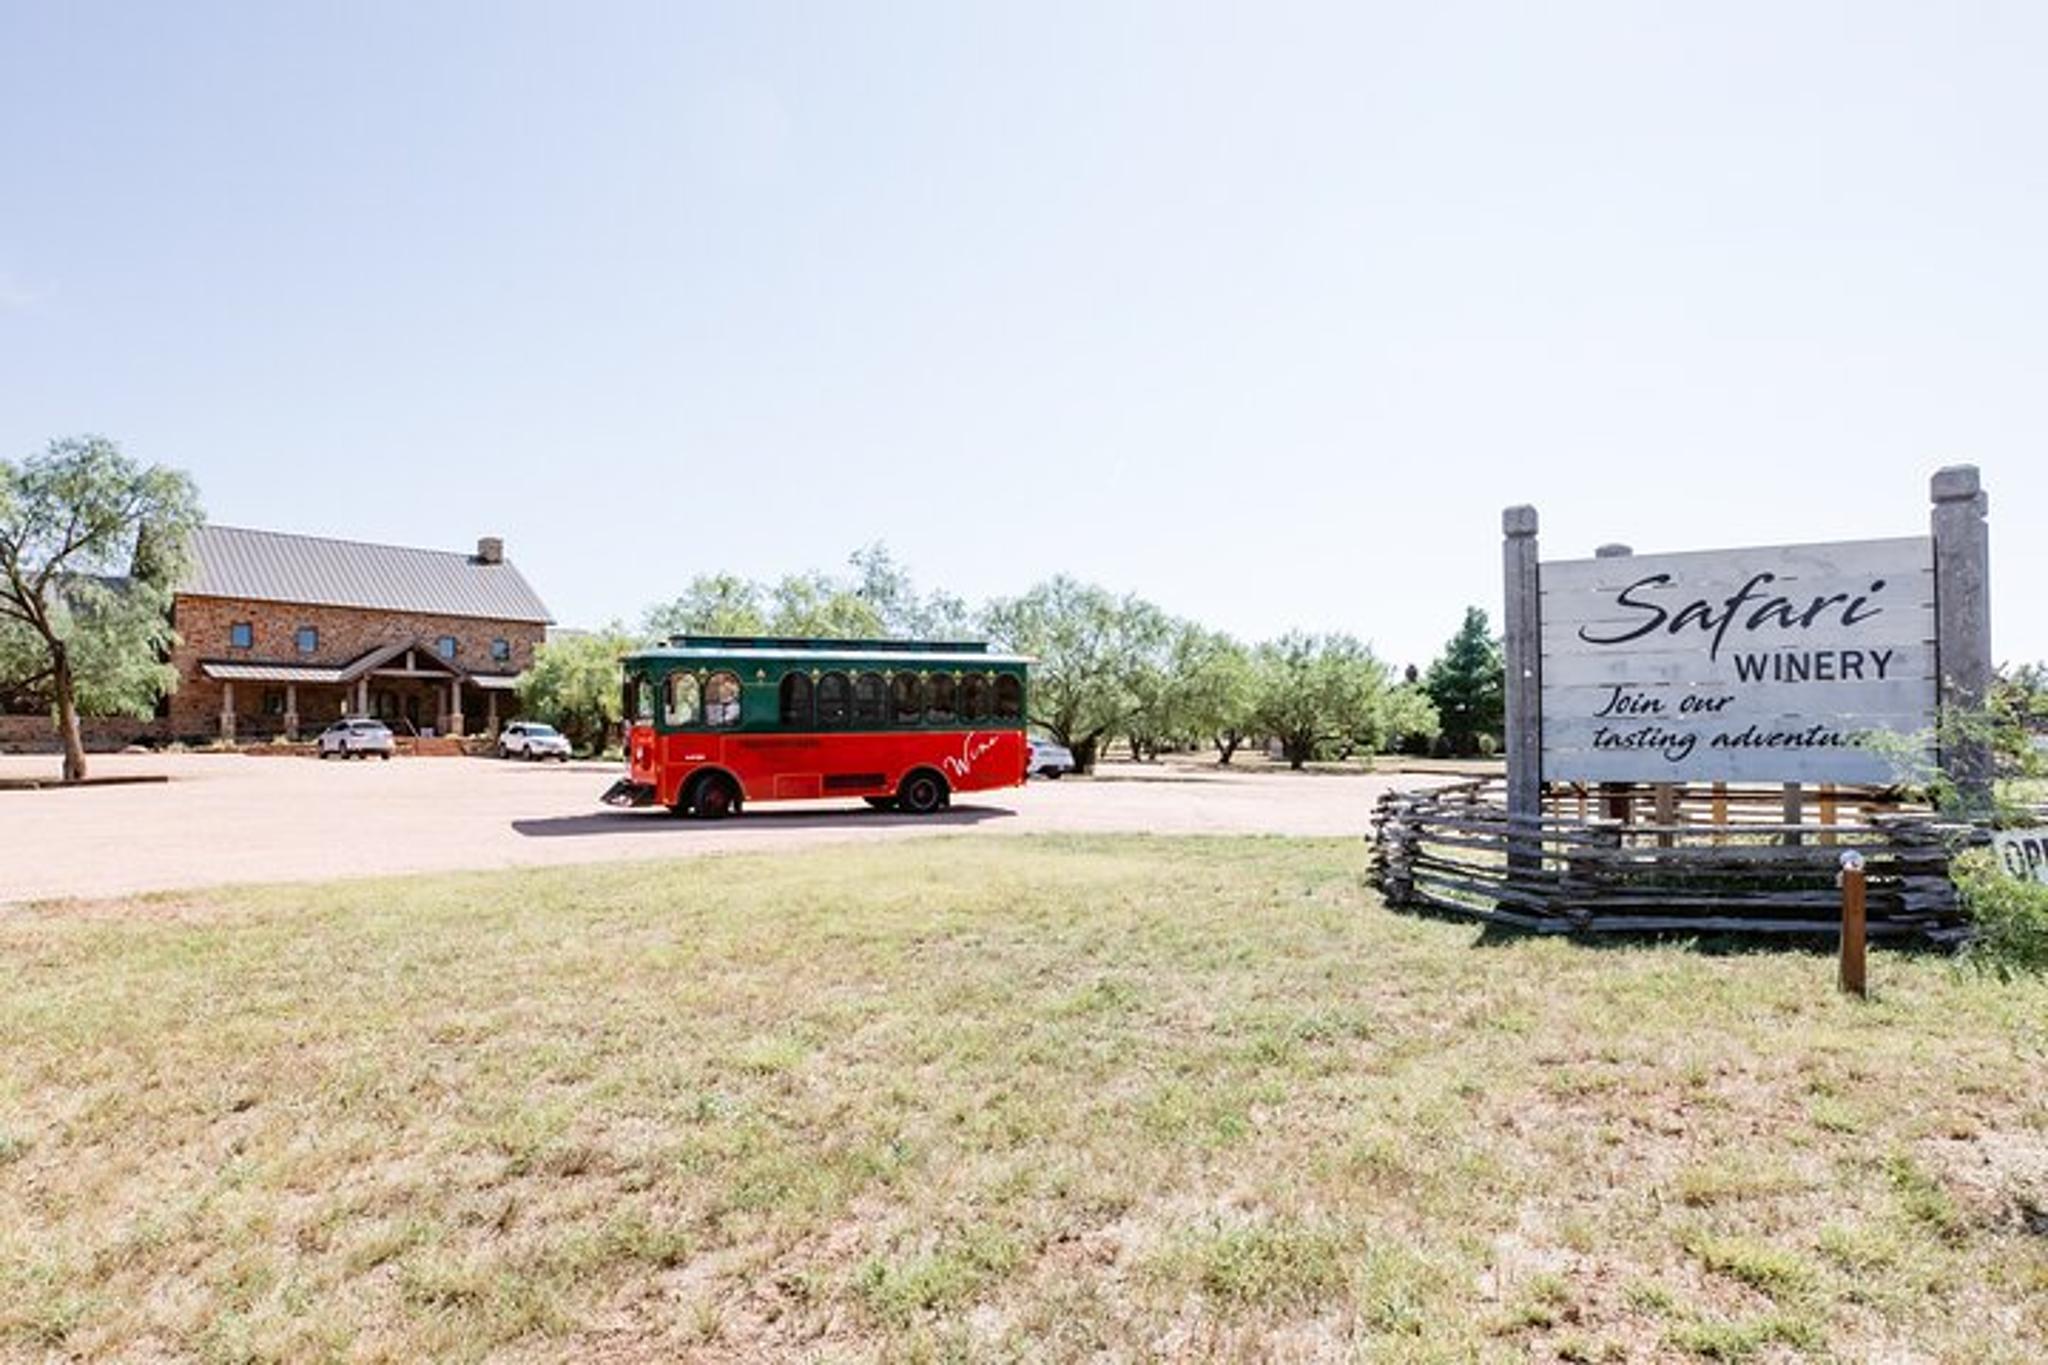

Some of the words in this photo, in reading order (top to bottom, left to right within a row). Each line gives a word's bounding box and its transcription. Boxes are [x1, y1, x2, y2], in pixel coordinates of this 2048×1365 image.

[1578, 573, 1886, 661] Safari
[1735, 649, 1893, 682] WINERY
[1594, 685, 1665, 717] Join
[1680, 694, 1735, 713] our
[1594, 726, 1697, 762] tasting
